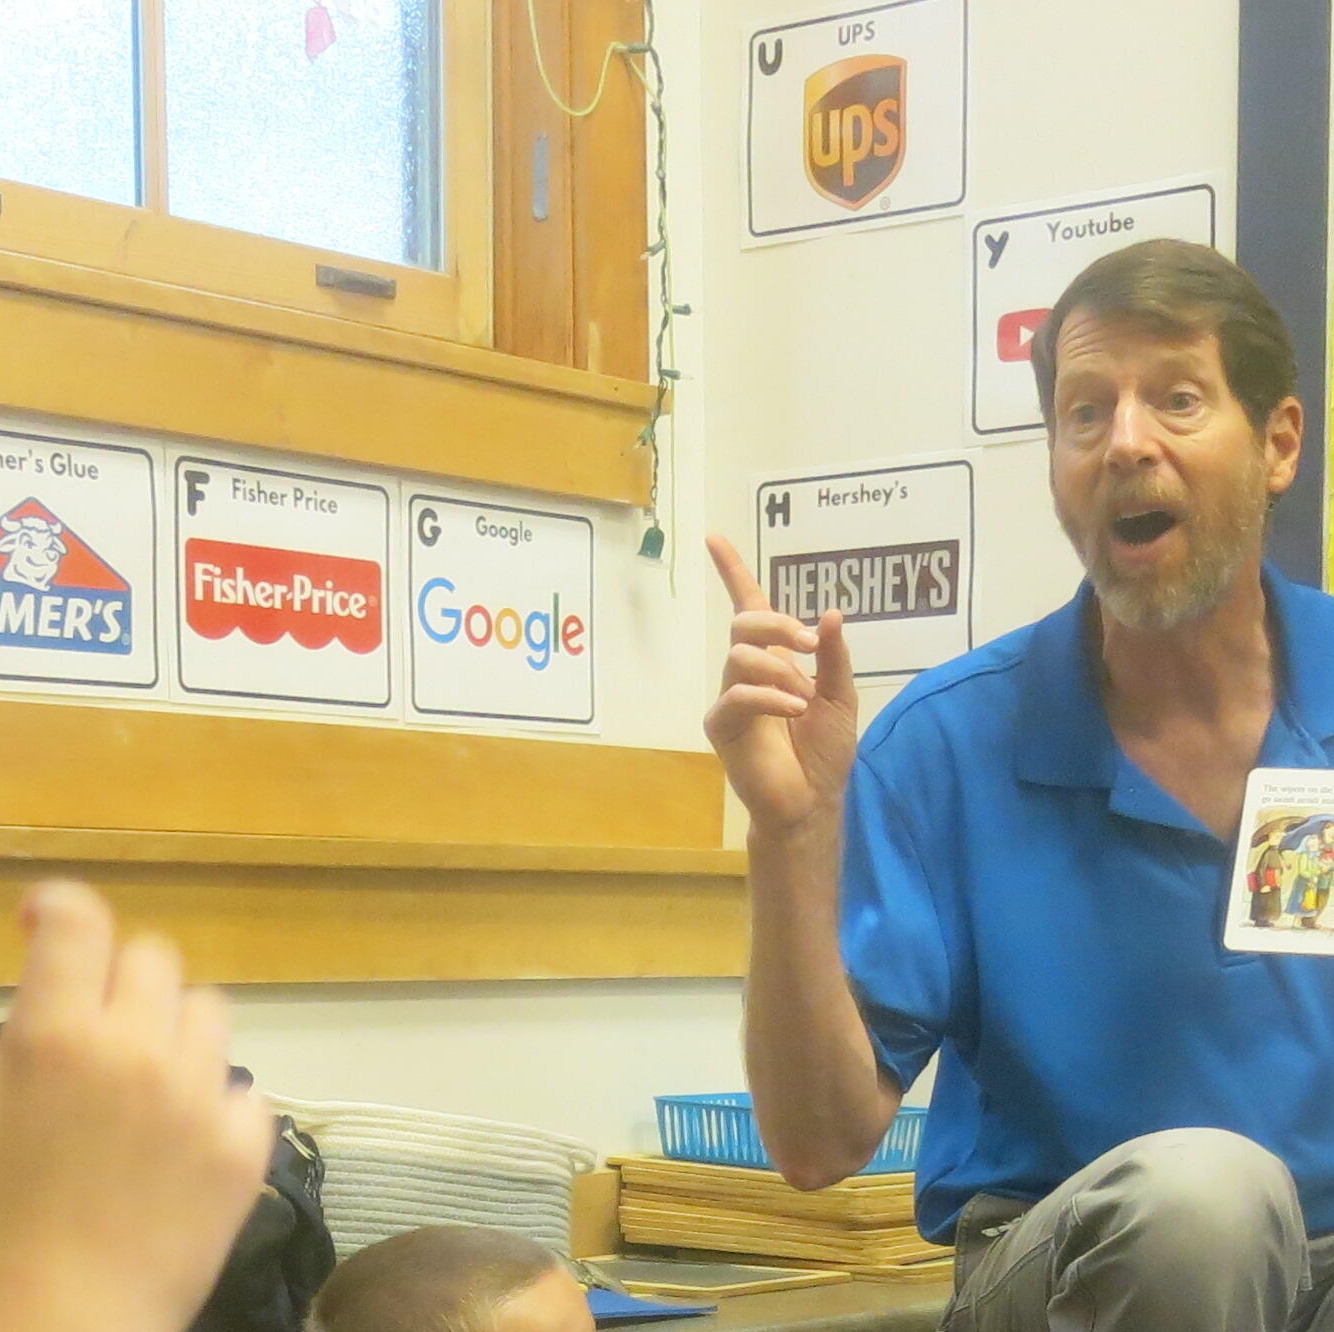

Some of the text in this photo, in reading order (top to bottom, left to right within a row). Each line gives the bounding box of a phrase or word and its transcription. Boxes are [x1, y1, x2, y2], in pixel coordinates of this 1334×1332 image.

[838, 20, 875, 46] UPS
[758, 38, 783, 76] U
[811, 98, 900, 187] ups
[1046, 211, 1135, 243] Youtube
[984, 230, 1009, 269] Y
[49, 452, 99, 480] Glue
[184, 469, 211, 516] F
[231, 477, 338, 514] Fisher Price
[765, 491, 790, 528] H
[817, 480, 908, 508] Hershey's
[417, 507, 442, 547] G
[475, 515, 533, 547] Google
[777, 549, 951, 620] HERSHEY'S
[417, 577, 585, 671] Google
